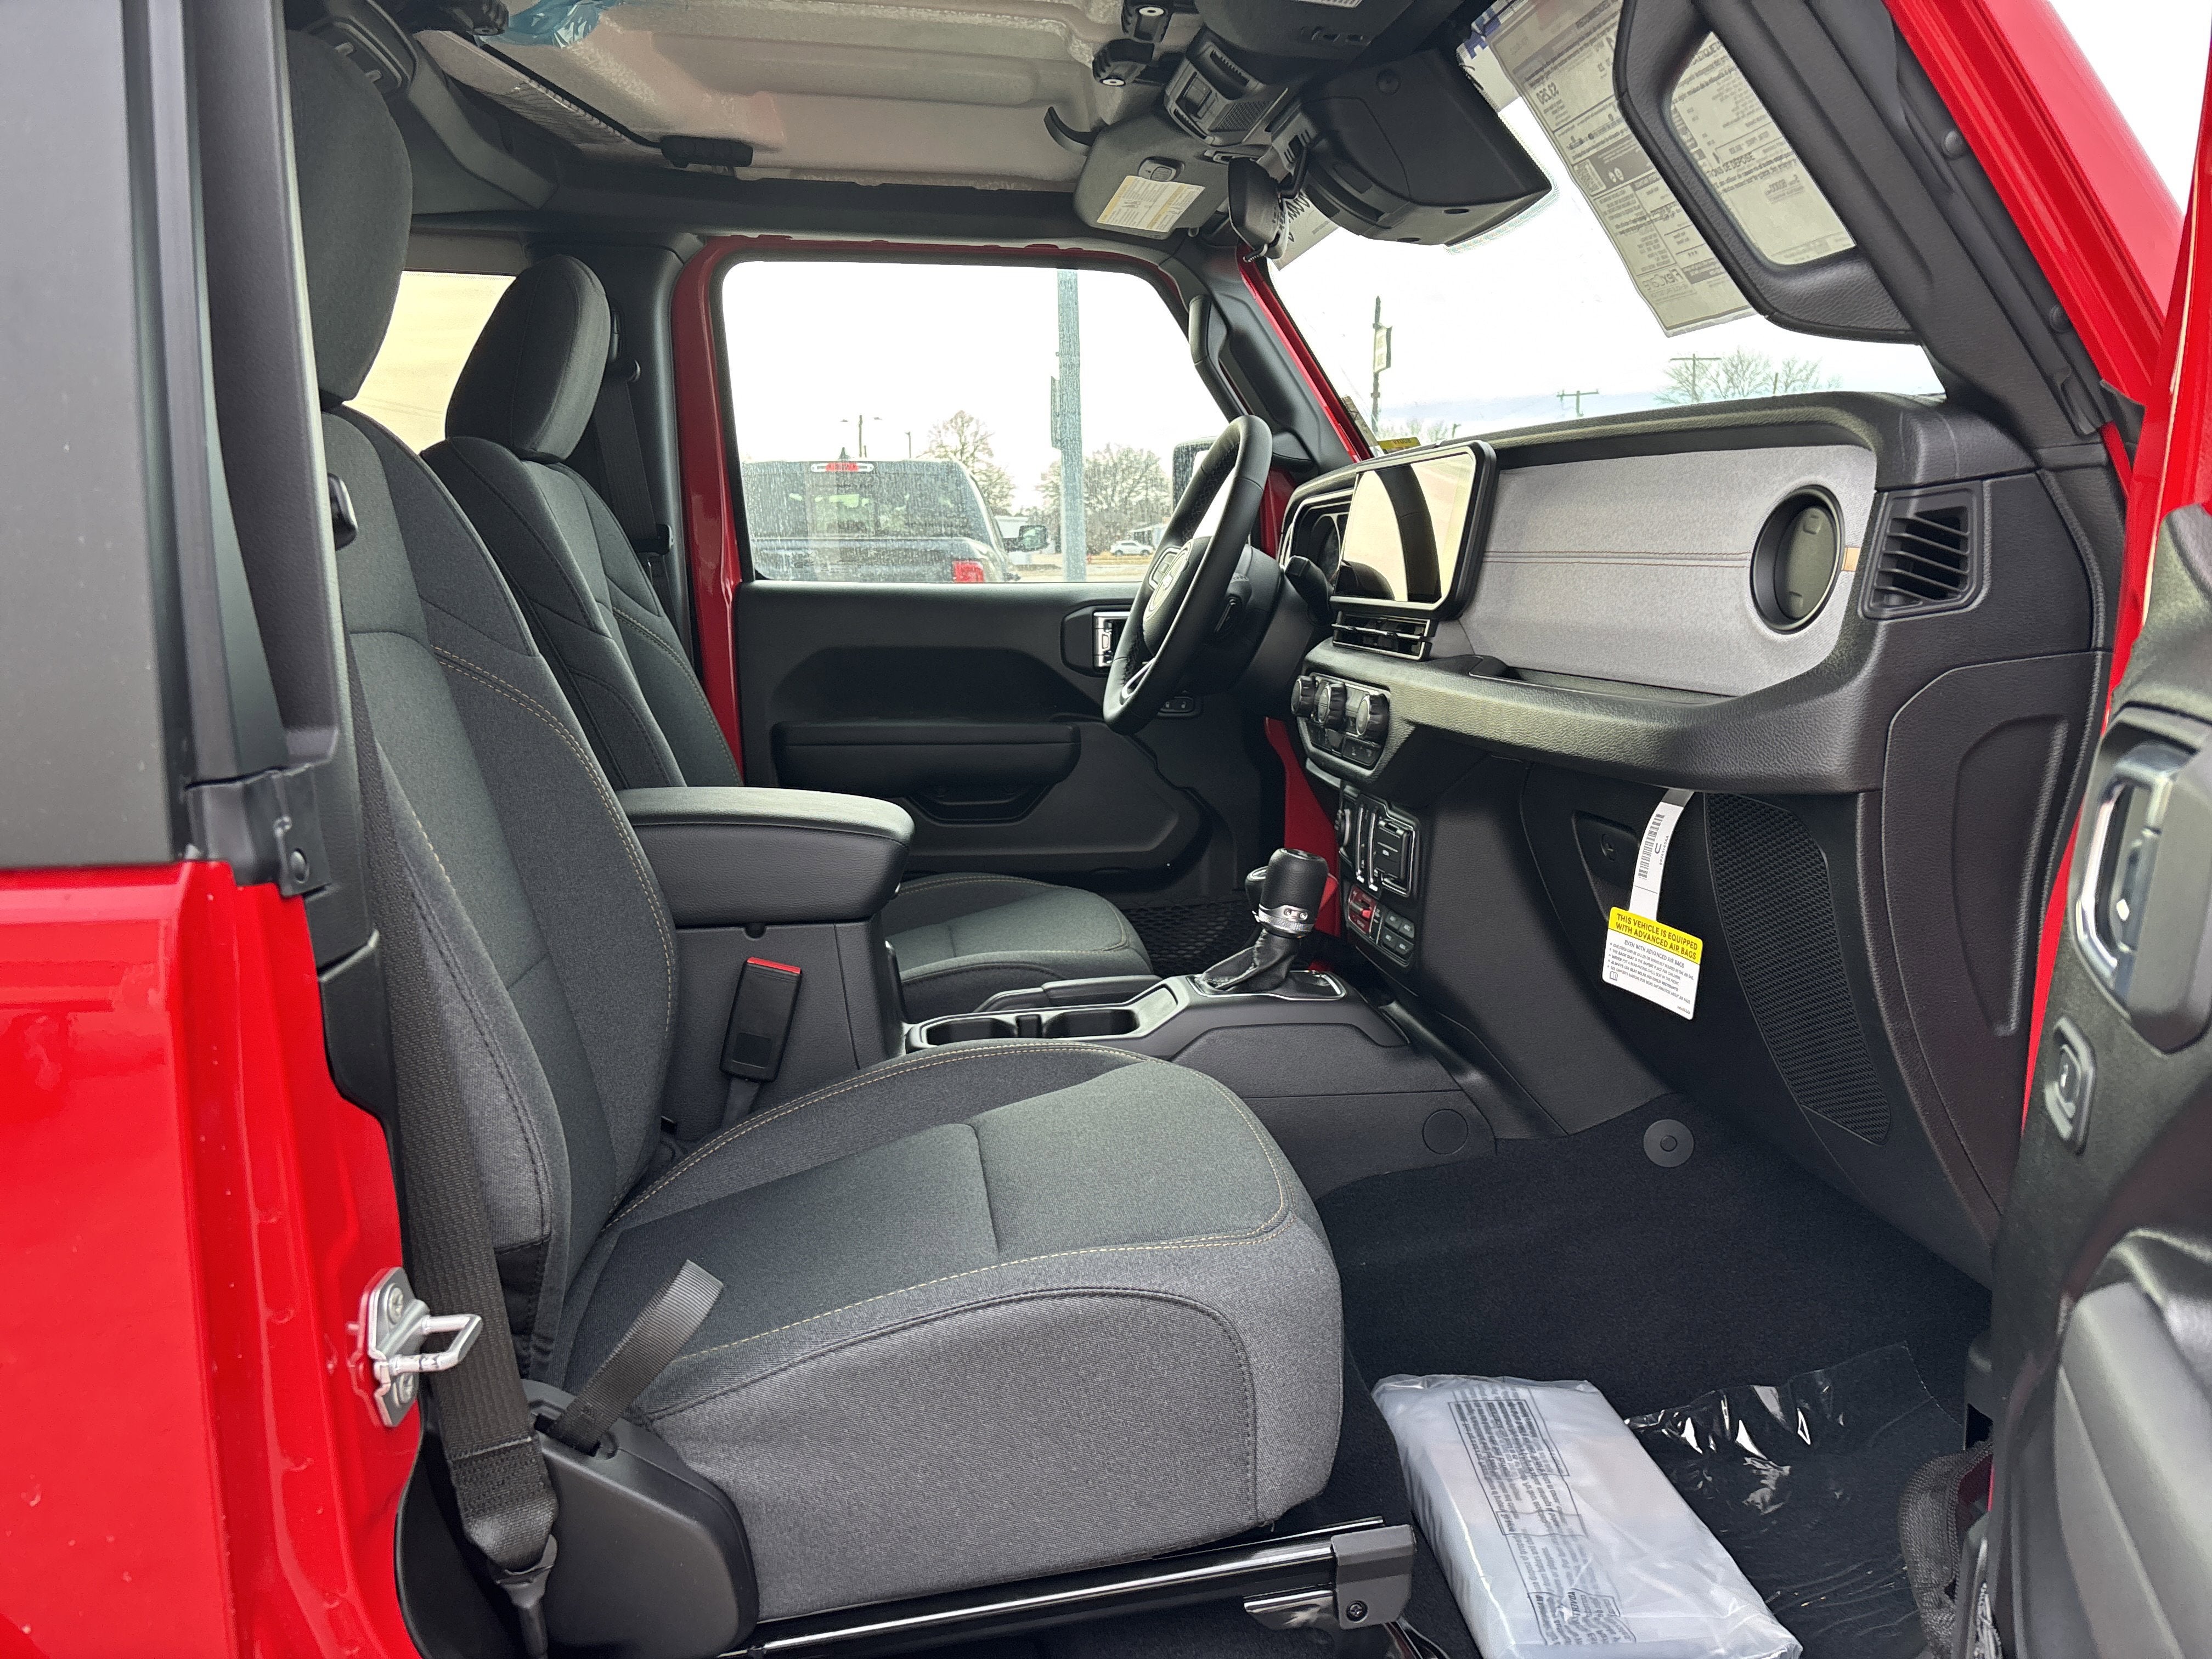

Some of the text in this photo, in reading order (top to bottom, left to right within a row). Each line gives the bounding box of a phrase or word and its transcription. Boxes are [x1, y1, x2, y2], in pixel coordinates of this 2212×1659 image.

[1615, 921, 1696, 960] WITH ADVANCED AIR BAGS
[1616, 912, 1698, 951] THIS VEHICLE IS EQUIPPED
[1624, 939, 1635, 948] EVEN
[1635, 943, 1646, 952] WITH
[1646, 947, 1667, 961] ADVANCED
[1674, 960, 1684, 968] BAGS
